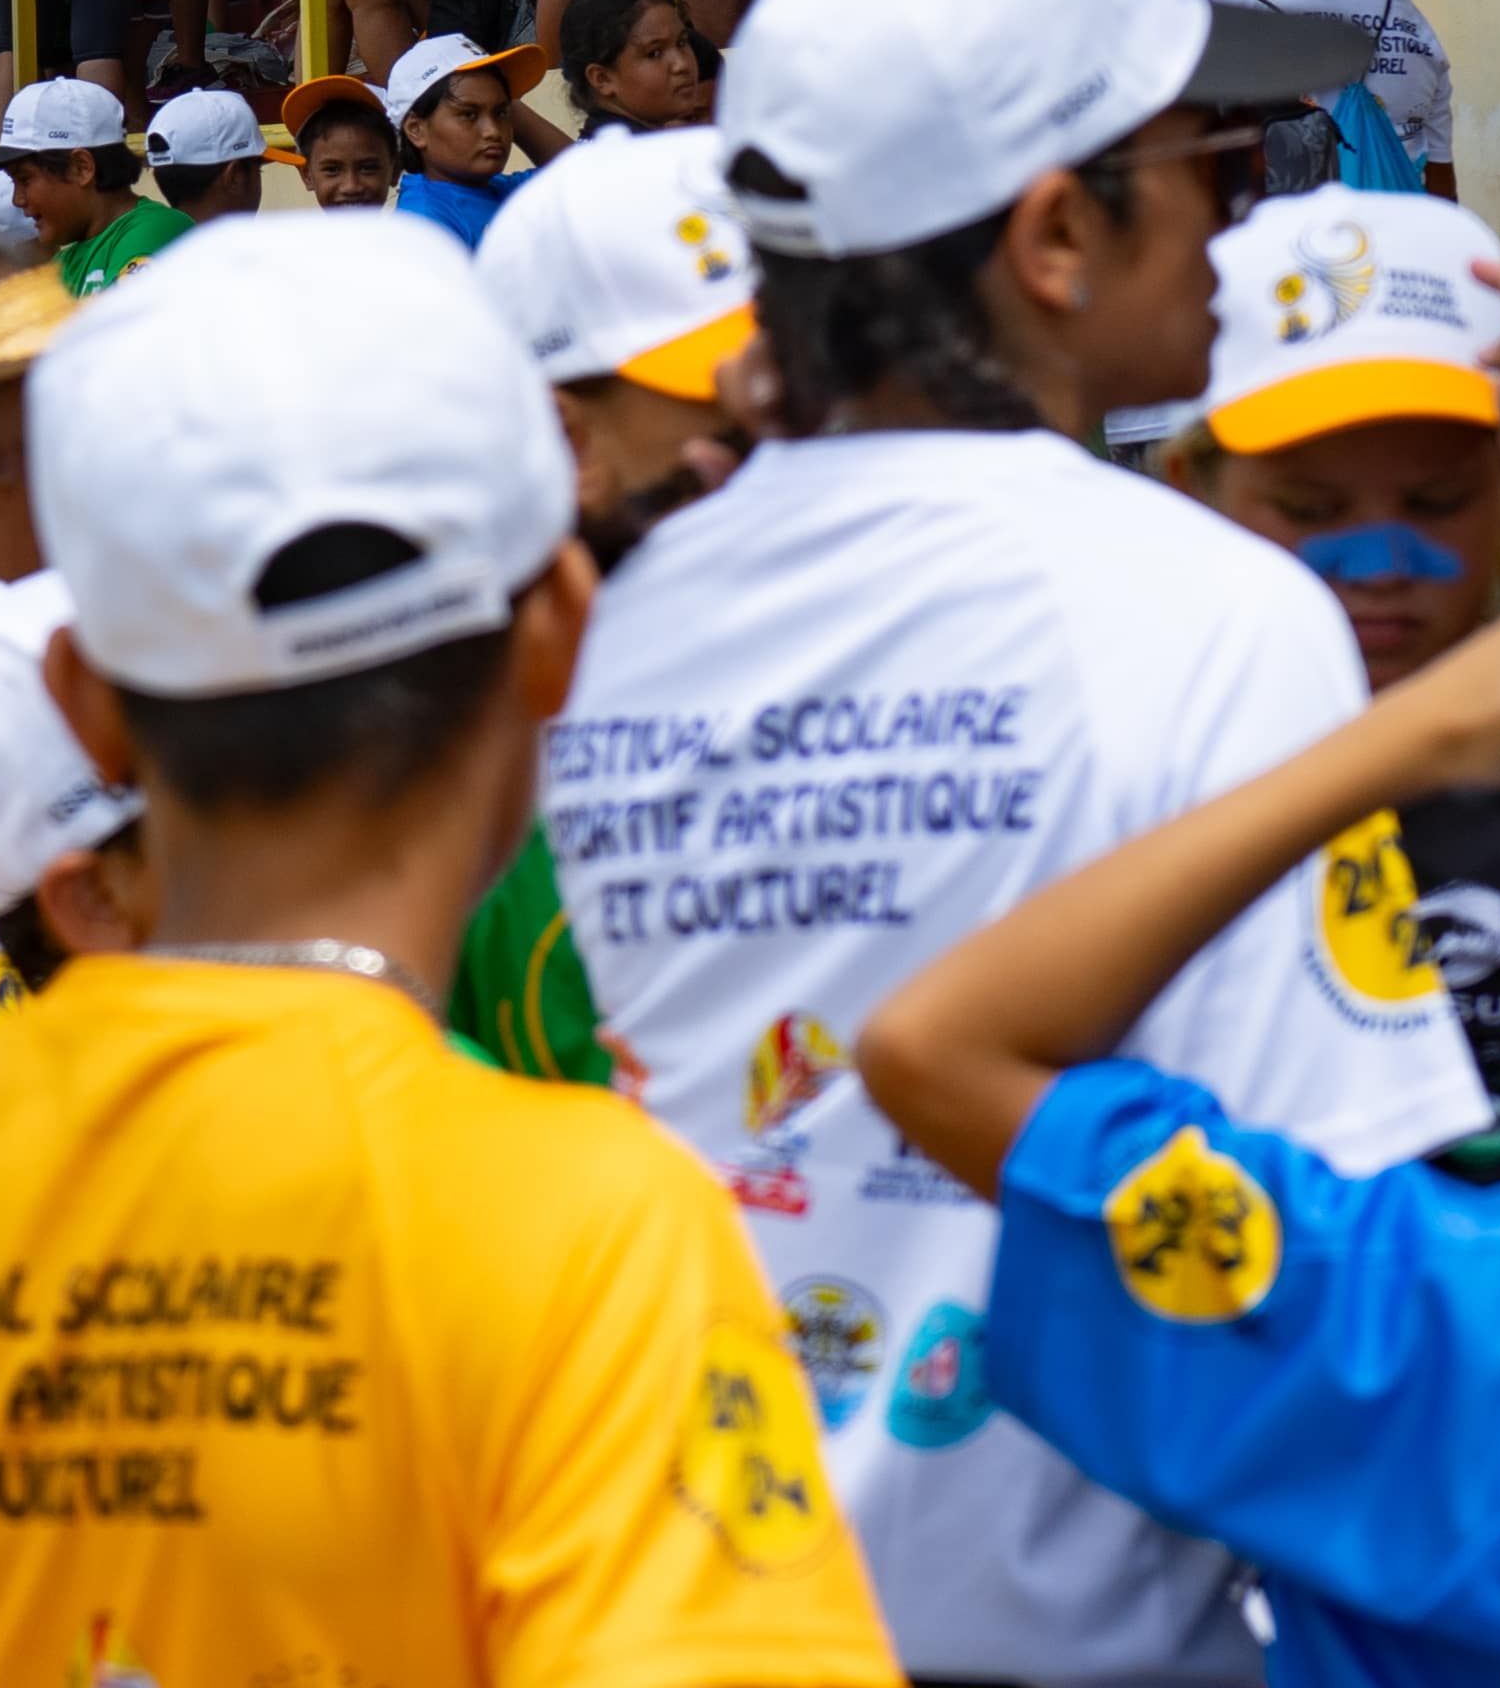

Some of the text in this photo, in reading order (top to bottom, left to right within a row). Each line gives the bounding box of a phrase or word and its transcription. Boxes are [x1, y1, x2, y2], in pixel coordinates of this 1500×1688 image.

[749, 682, 1026, 762] SCOLAIRE
[711, 768, 1044, 851] ARTISTIQUE
[604, 857, 914, 944] ET CULTUREL
[53, 1251, 345, 1337] SCOLAIRE
[2, 1352, 363, 1436] ARTISTIQUE
